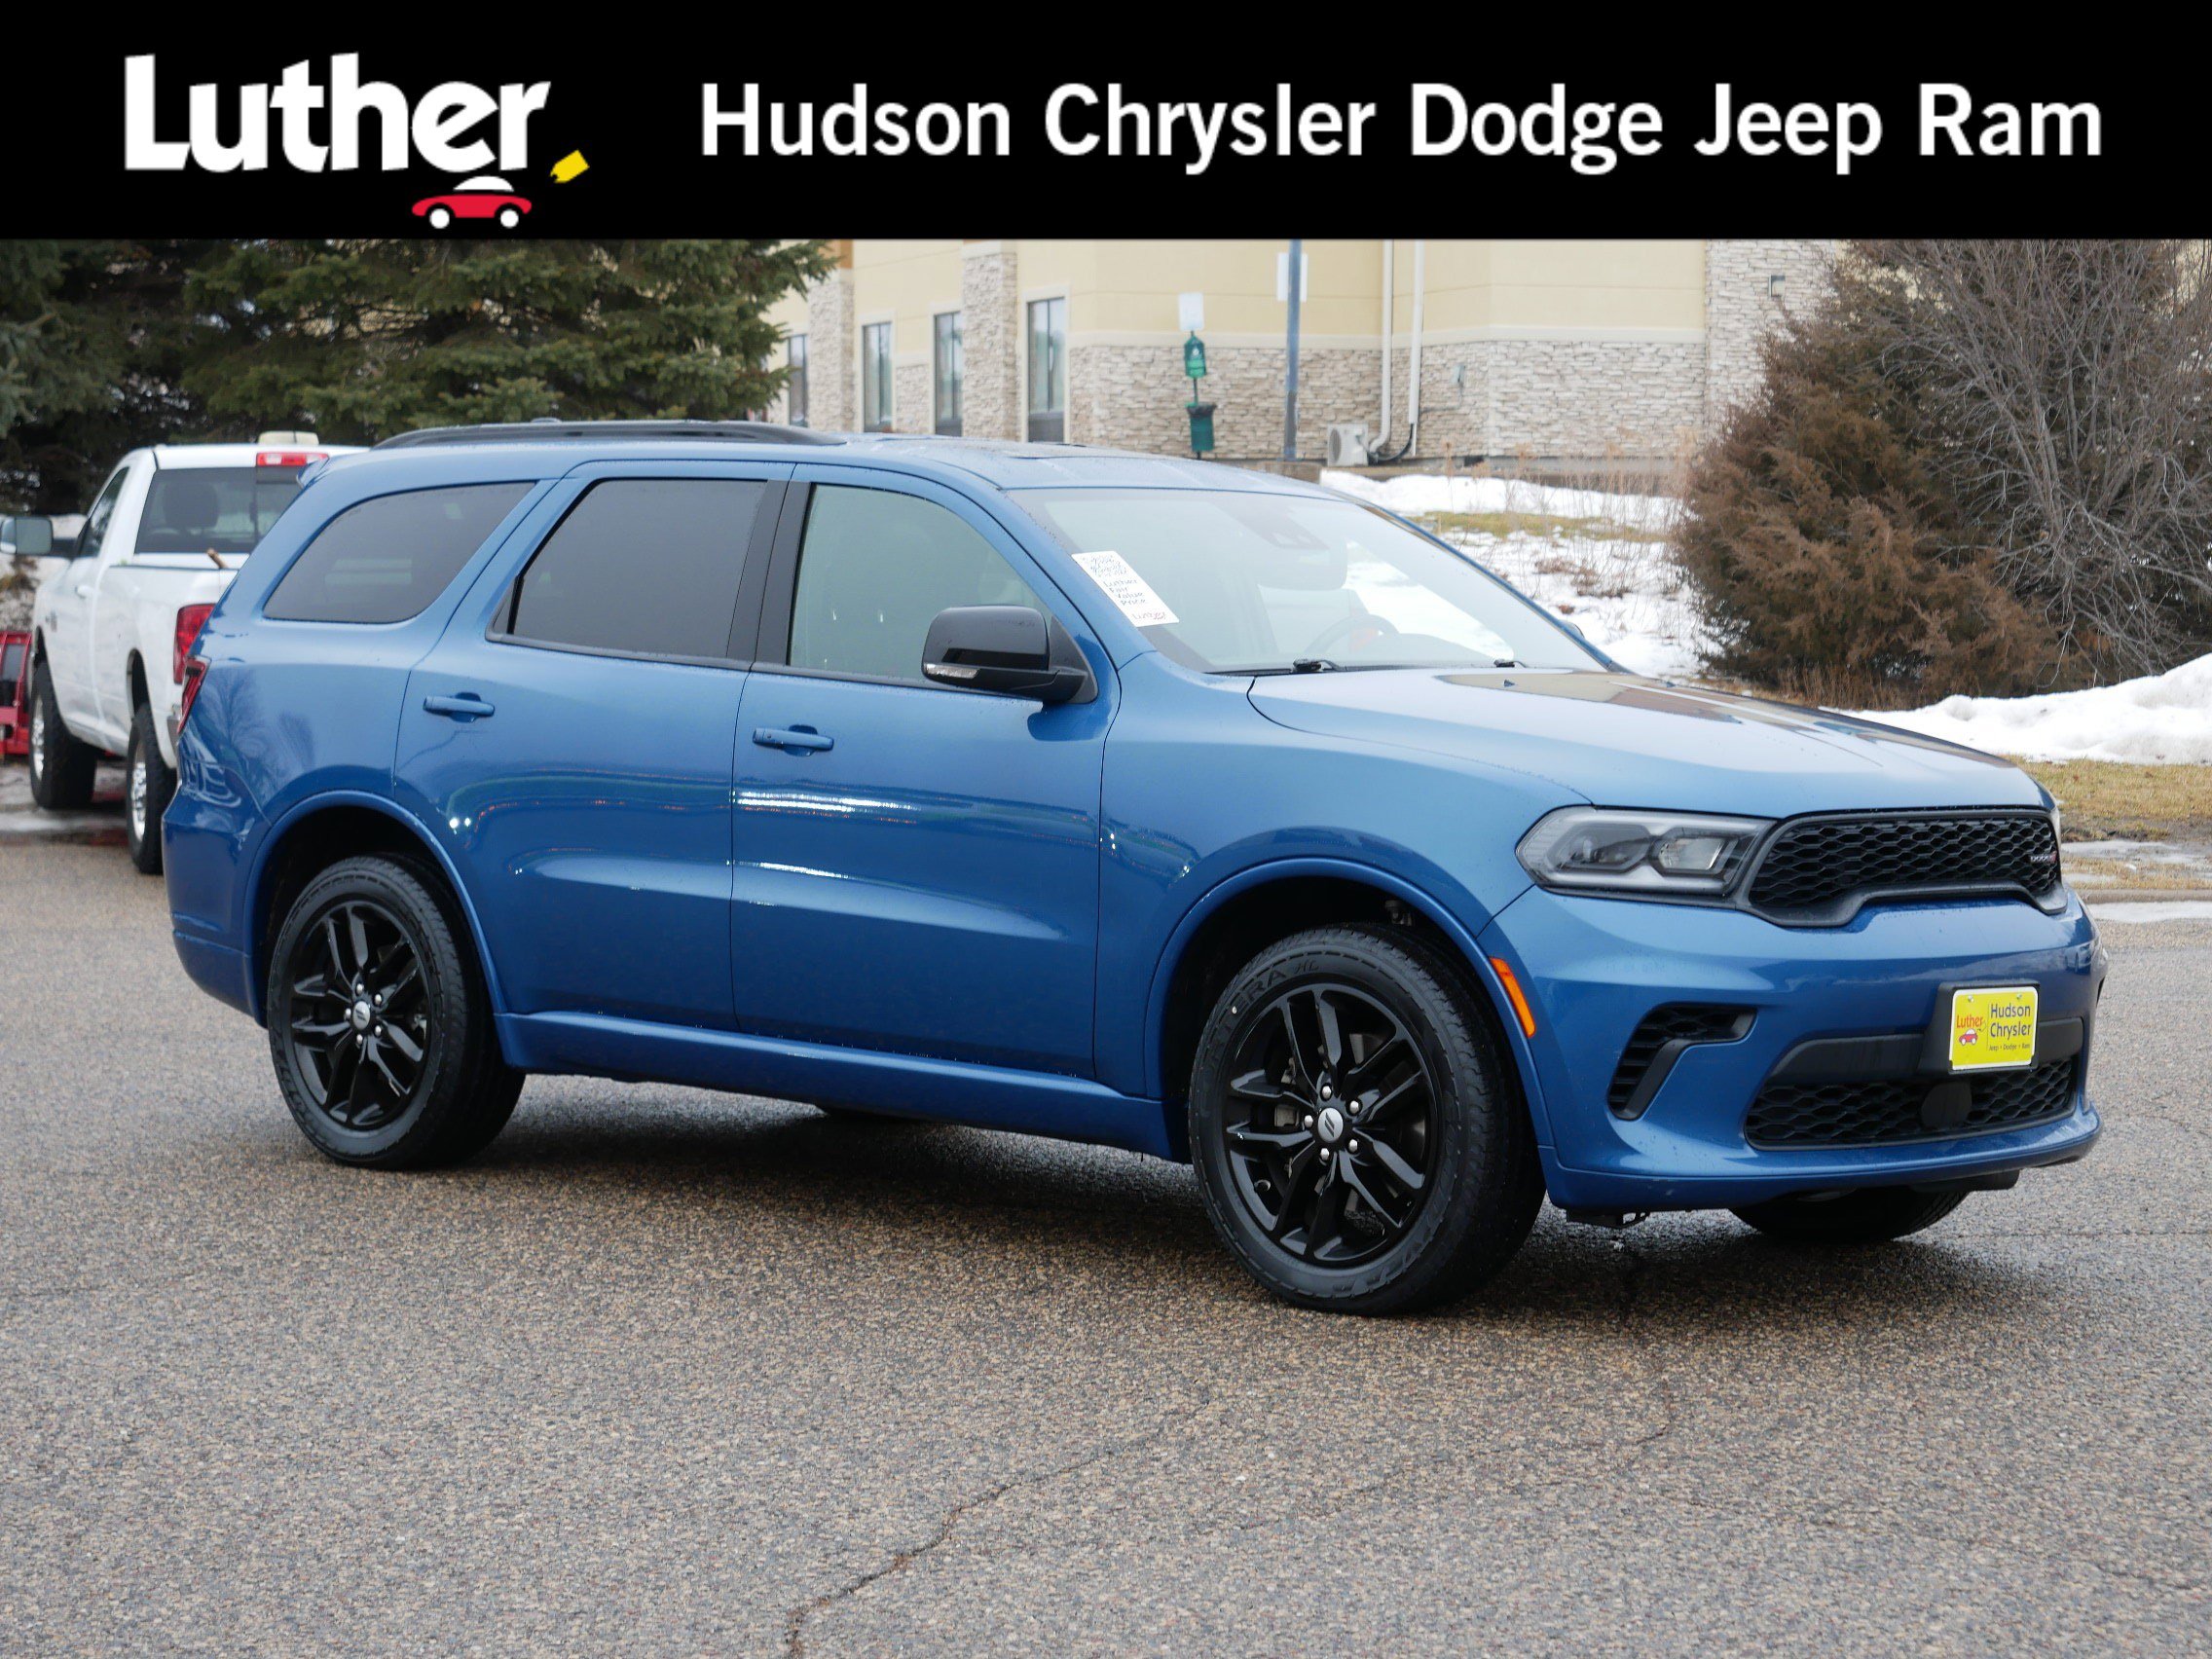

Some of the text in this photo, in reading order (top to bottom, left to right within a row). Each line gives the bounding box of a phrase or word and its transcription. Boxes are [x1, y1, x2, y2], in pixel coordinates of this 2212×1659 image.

[1990, 1003, 2031, 1018] Hudson
[1956, 1014, 1983, 1029] Luther
[1990, 1021, 2032, 1040] Chrysler
